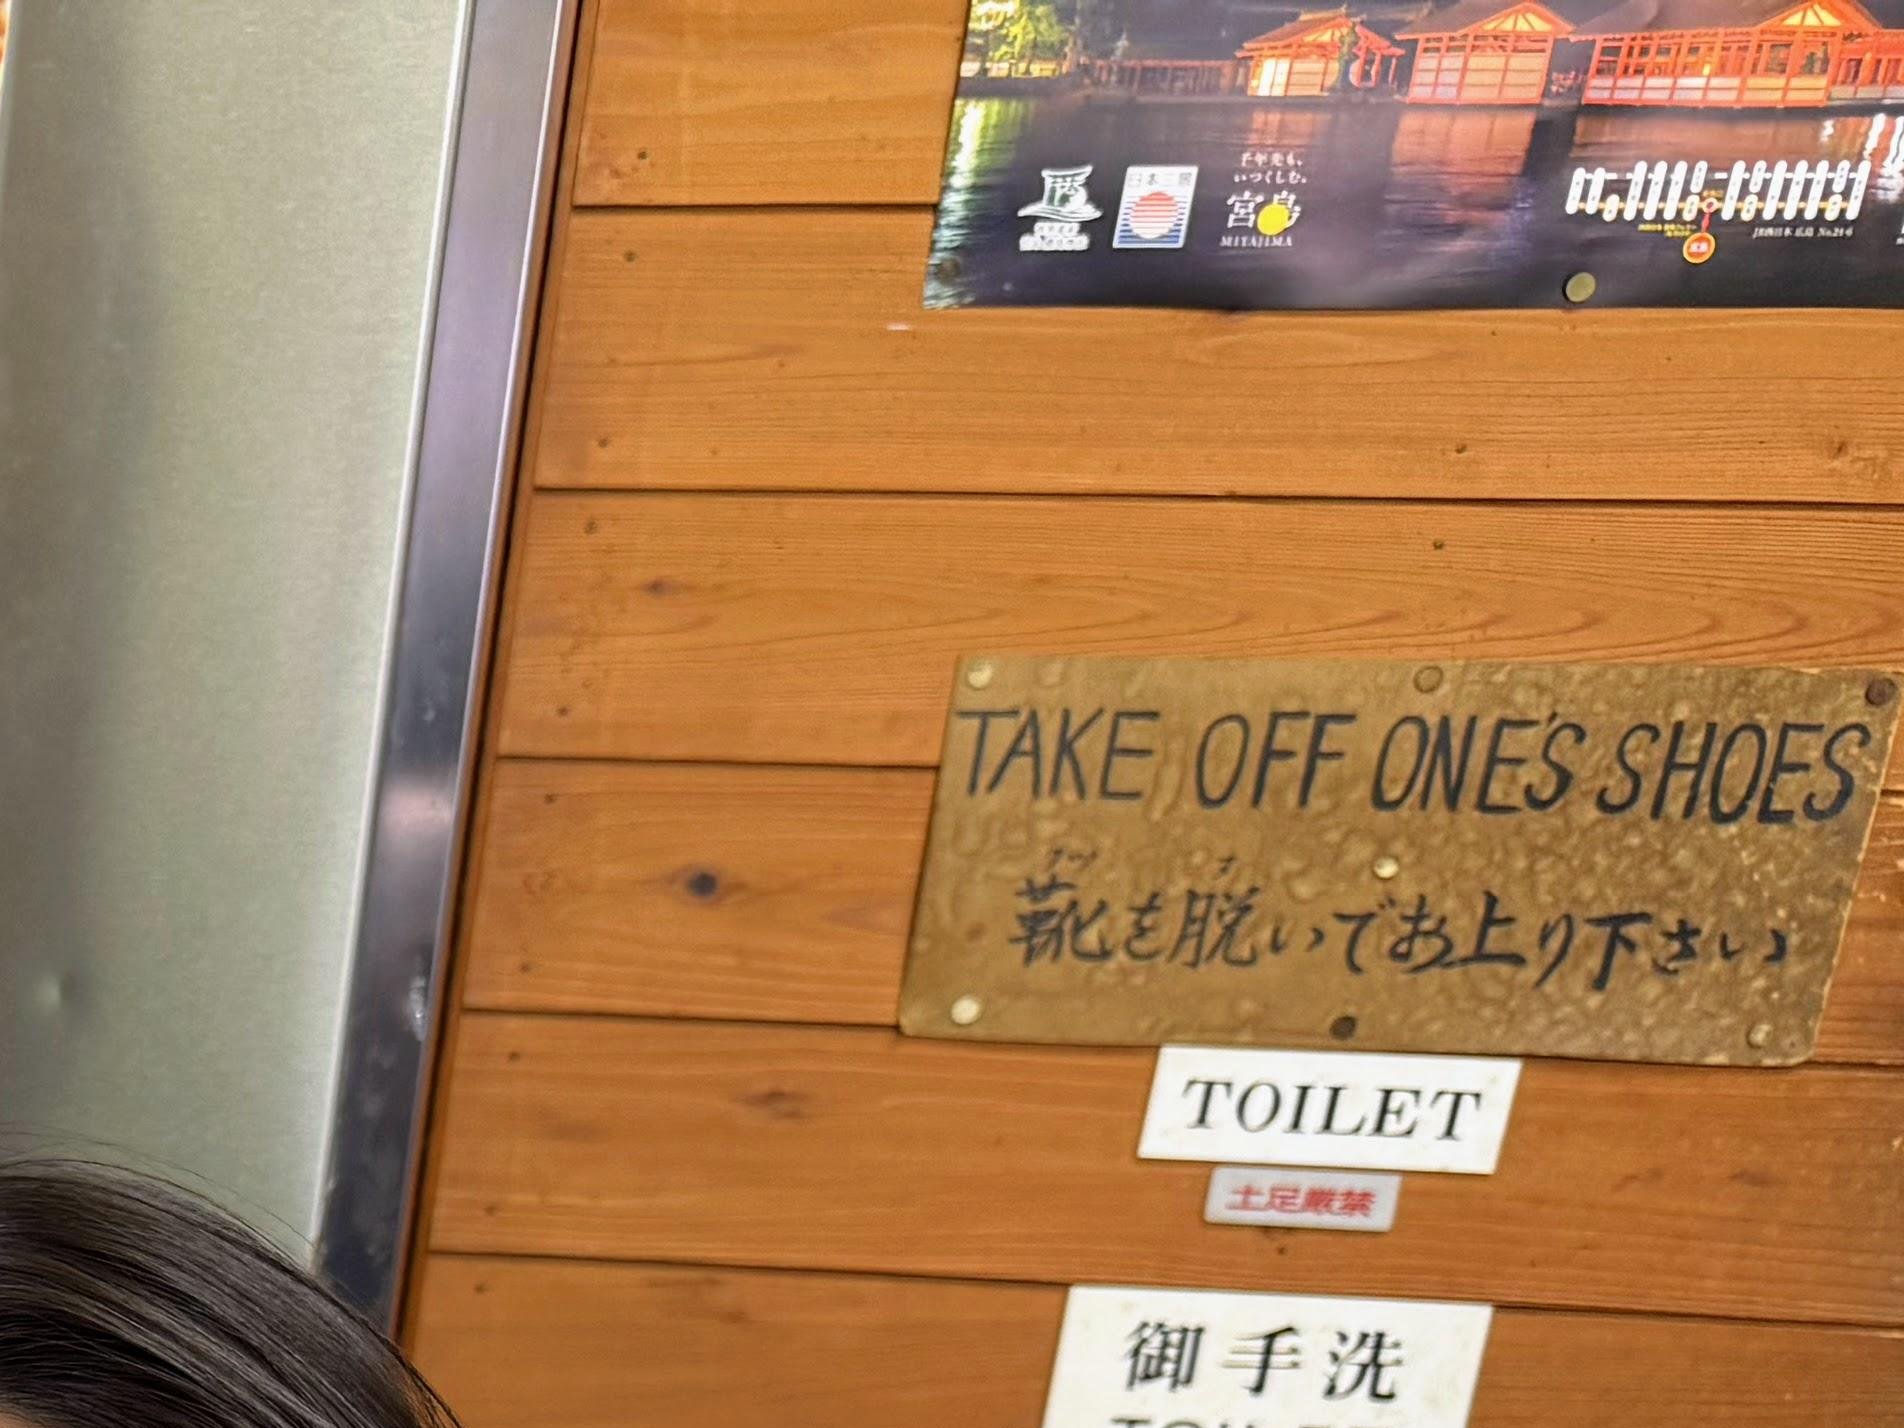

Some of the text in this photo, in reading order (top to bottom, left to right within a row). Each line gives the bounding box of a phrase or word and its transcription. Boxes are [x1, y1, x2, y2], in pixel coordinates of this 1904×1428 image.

[1219, 236, 1292, 248] MIYAJIMA
[955, 706, 1161, 799] TAKE
[1195, 711, 1357, 810] OFF
[1595, 719, 1872, 827] SHOES
[1182, 1077, 1482, 1143] TOILET
[1122, 1320, 1405, 1405] 御手洗
